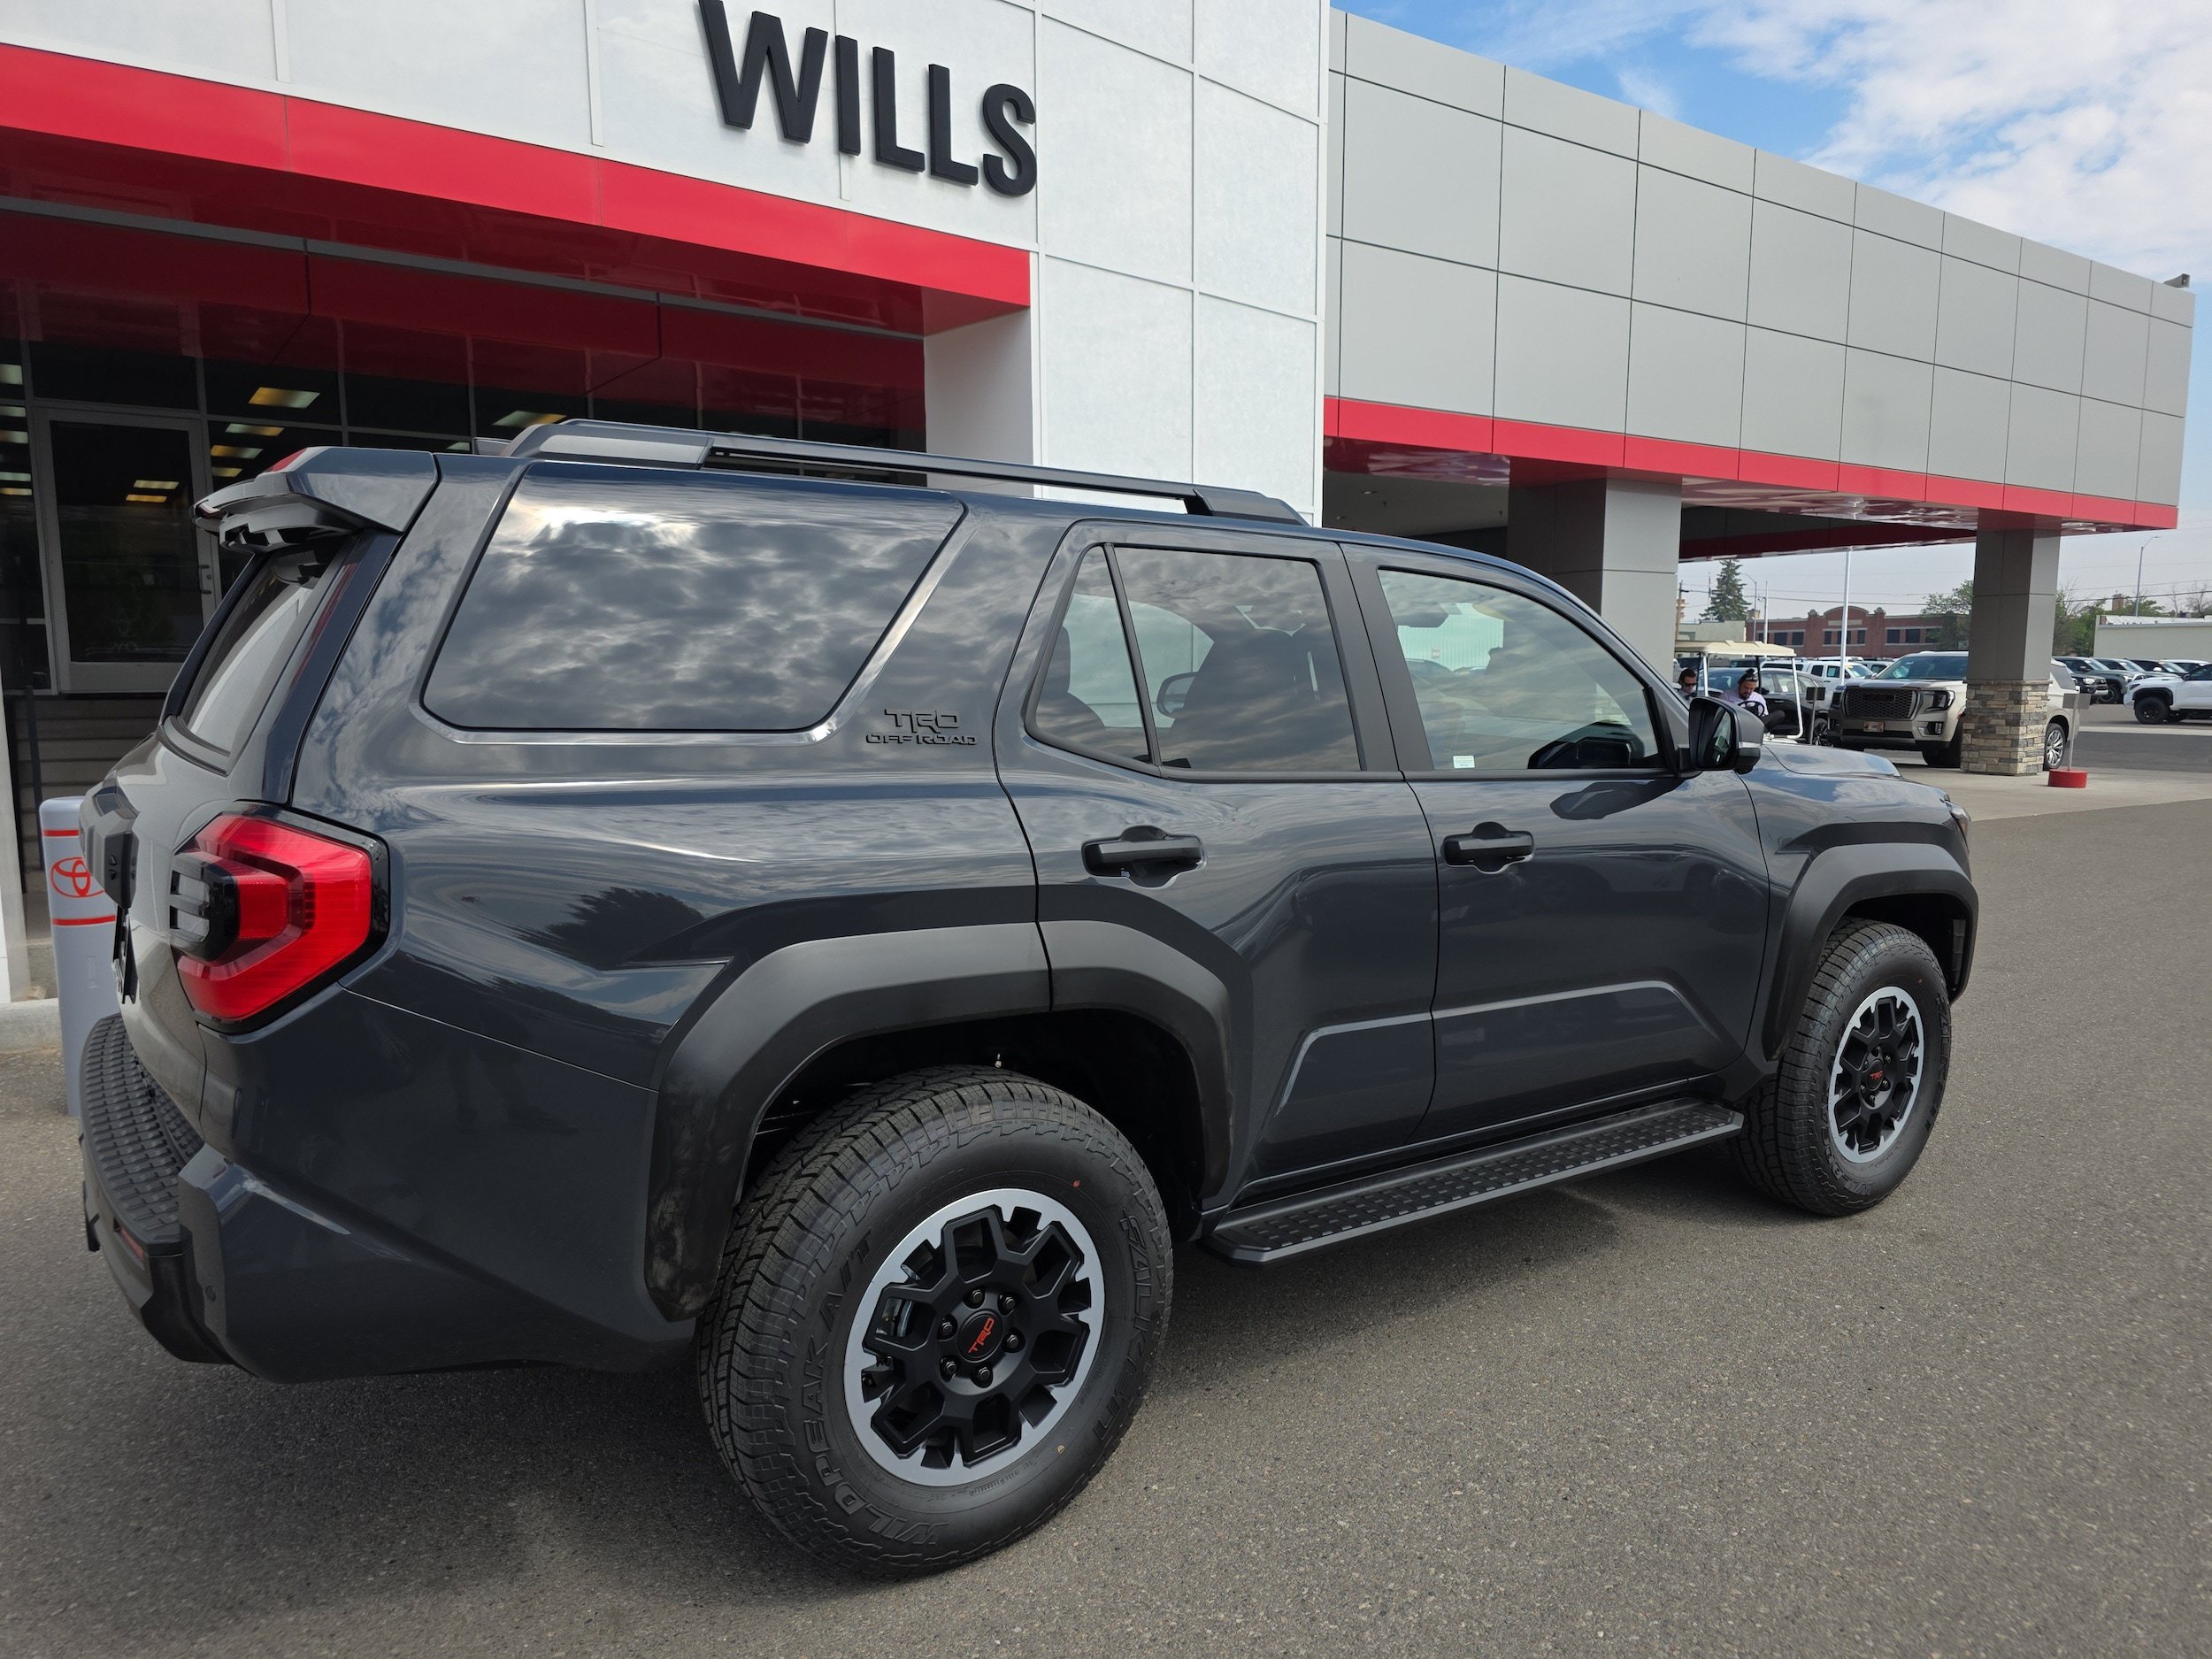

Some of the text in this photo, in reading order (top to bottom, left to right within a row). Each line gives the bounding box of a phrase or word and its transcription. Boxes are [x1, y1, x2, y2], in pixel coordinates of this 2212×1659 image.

[699, 0, 1036, 196] WILLS
[866, 733, 979, 746] OFF ROAD
[885, 709, 960, 733] TRD
[967, 1317, 995, 1354] TRD
[1093, 1207, 1152, 1441] FALKEN
[802, 1334, 949, 1546] WILDPEAK
